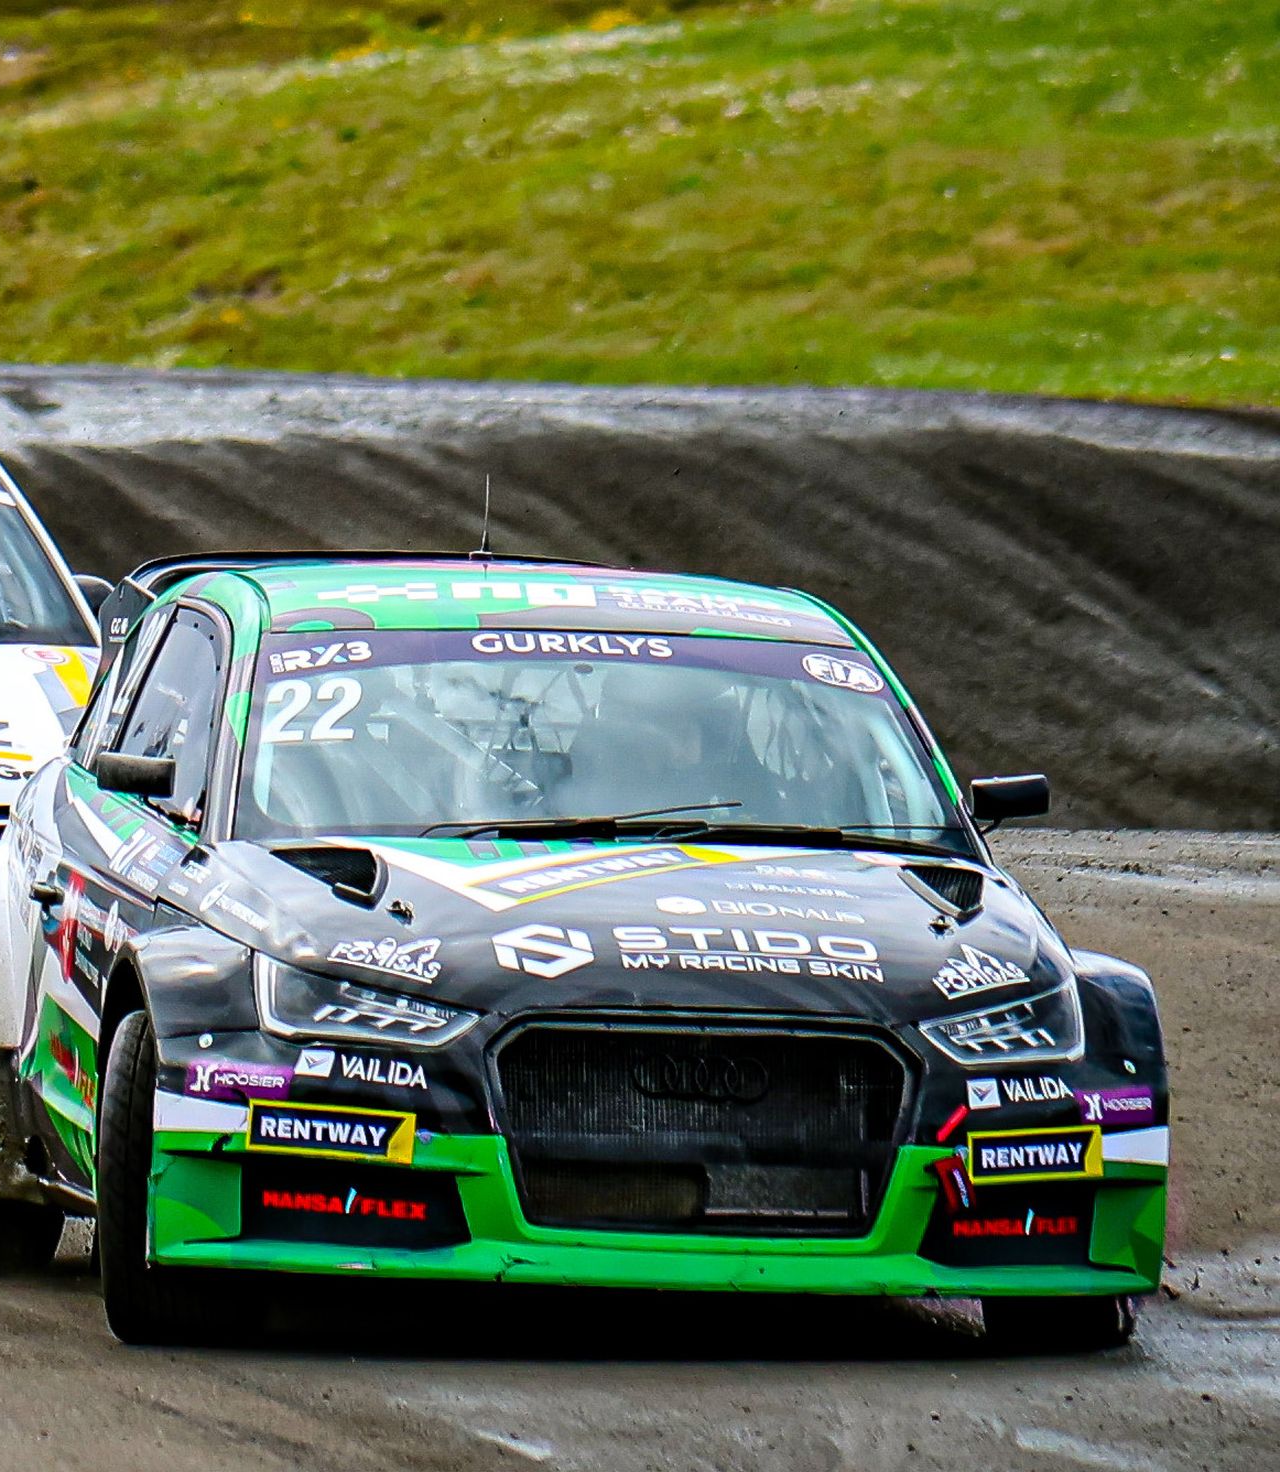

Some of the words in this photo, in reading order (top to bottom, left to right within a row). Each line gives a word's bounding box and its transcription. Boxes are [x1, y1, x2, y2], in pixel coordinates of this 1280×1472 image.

[283, 641, 372, 672] RX3
[471, 632, 673, 658] GURKLYS
[808, 657, 877, 687] FIA
[260, 677, 363, 743] 22
[613, 926, 878, 962] STIDO
[621, 955, 670, 970] MY
[679, 955, 801, 974] RACING
[809, 961, 884, 983] SKIN
[213, 1073, 285, 1088] HOOSIER
[340, 1054, 429, 1090] VAILIDA
[1001, 1076, 1075, 1102] VAILIDA
[259, 1114, 387, 1147] RENTWAY
[981, 1141, 1083, 1169] RENTWAY
